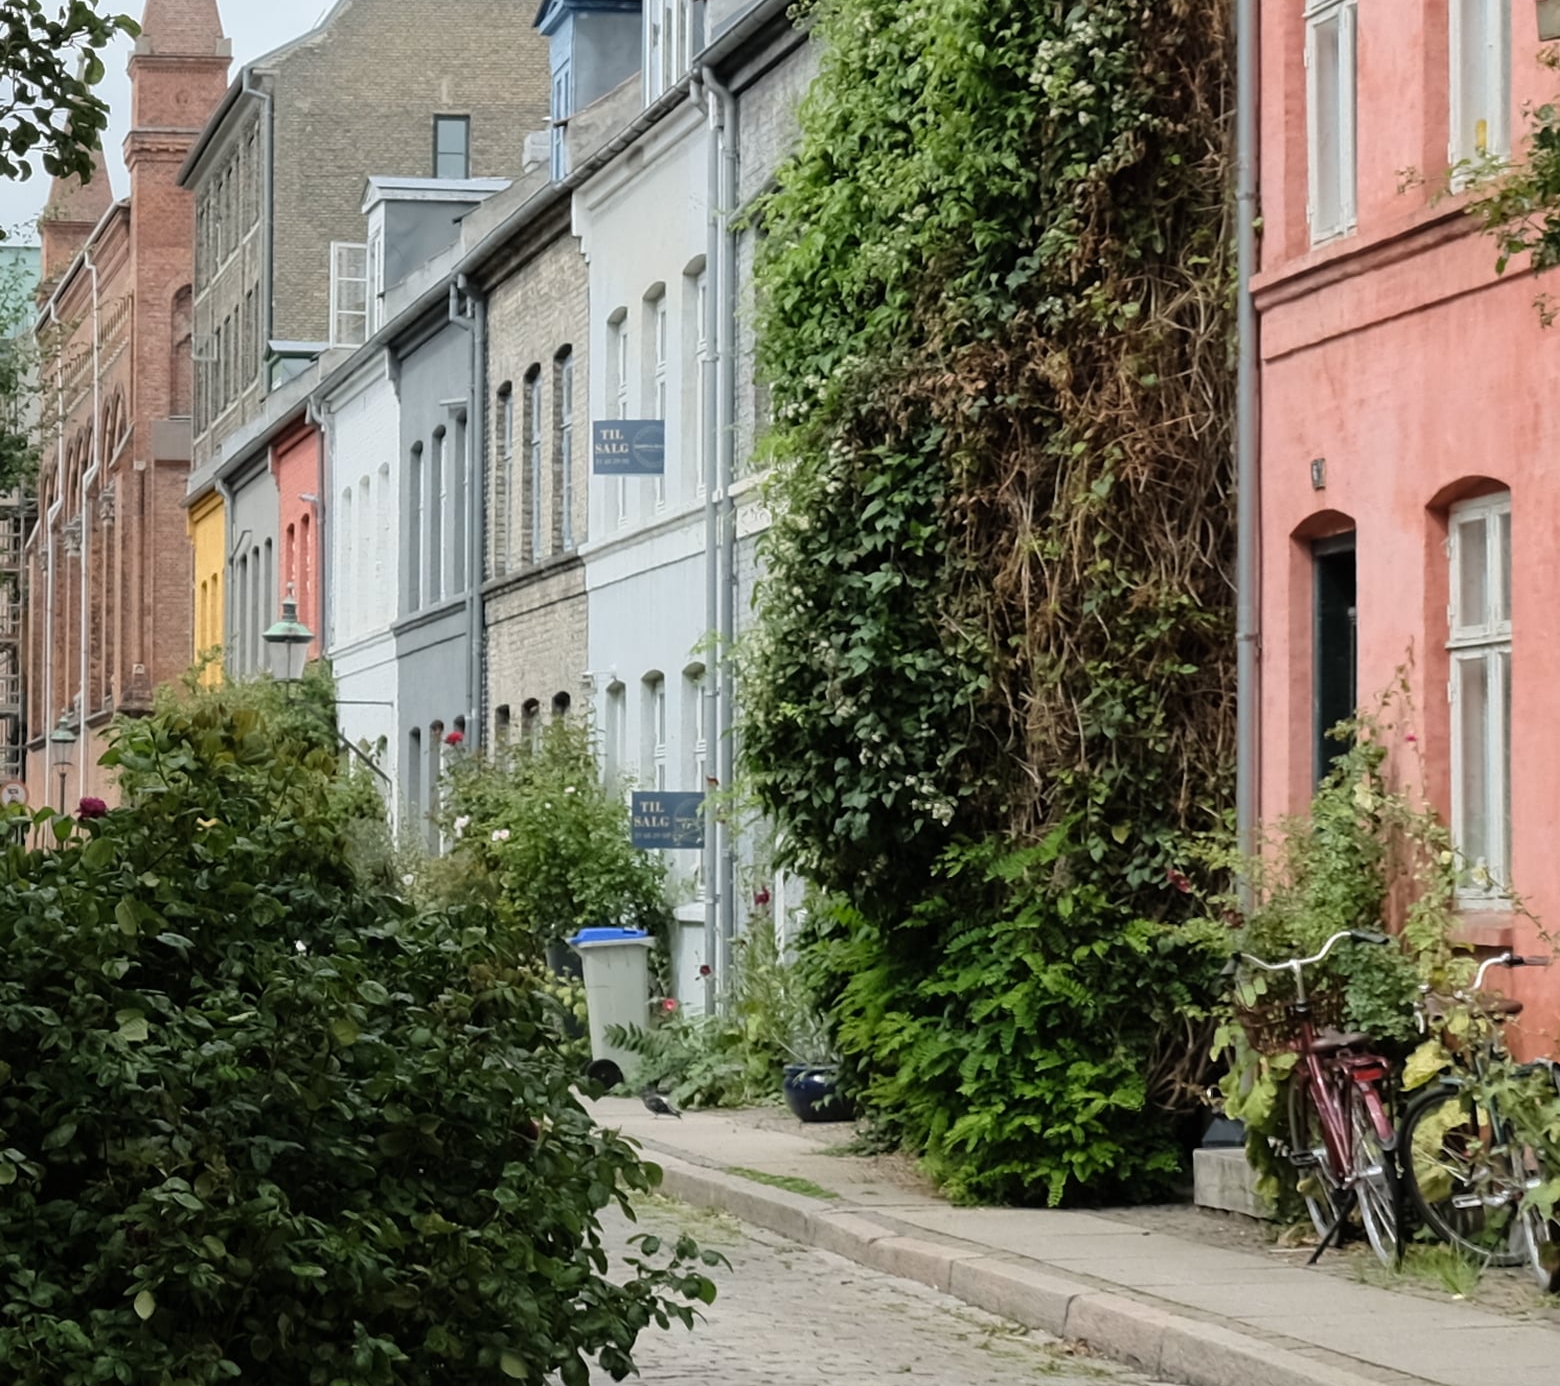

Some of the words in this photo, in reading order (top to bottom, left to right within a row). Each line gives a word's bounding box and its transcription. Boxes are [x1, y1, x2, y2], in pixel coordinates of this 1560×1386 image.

[600, 429, 624, 440] TIL
[595, 443, 629, 454] SALG
[640, 801, 664, 812] TIL
[634, 816, 670, 827] SALG
